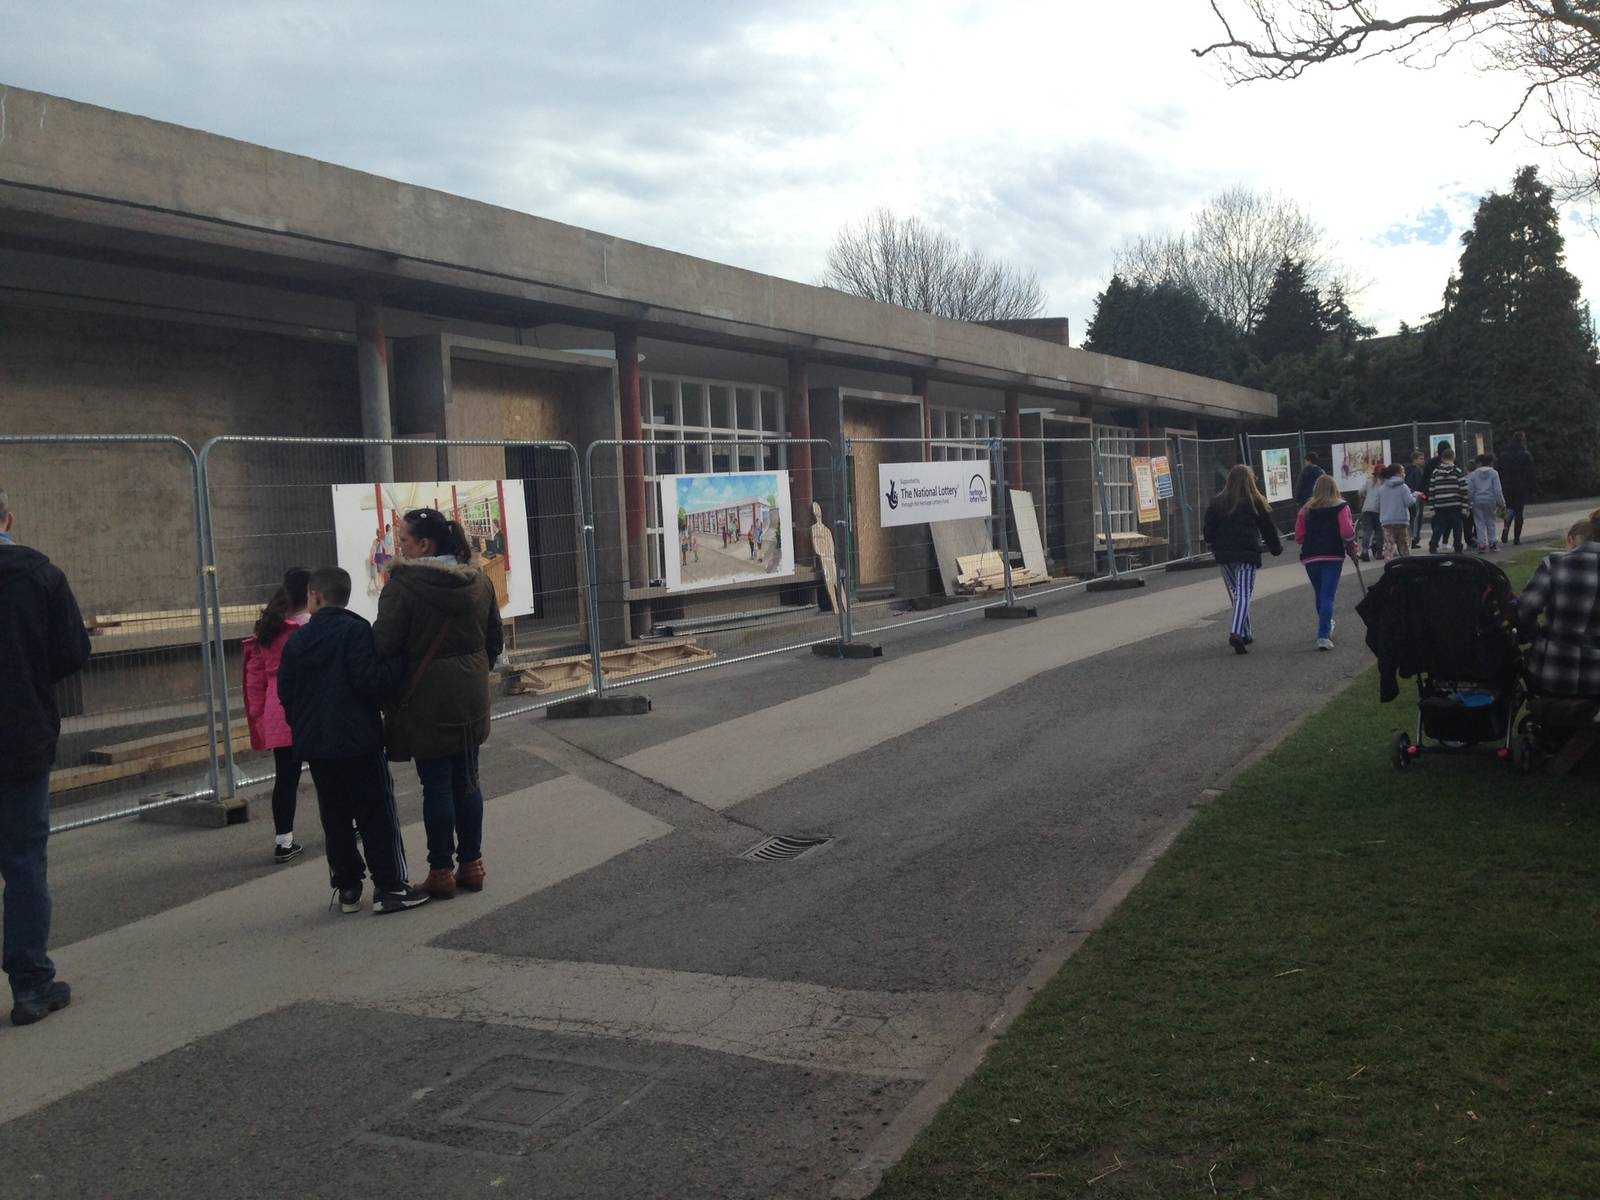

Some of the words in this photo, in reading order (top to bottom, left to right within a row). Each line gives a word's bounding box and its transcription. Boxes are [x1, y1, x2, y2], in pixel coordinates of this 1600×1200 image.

[901, 488, 912, 499] The
[913, 485, 937, 498] National
[938, 485, 958, 498] Lottery
